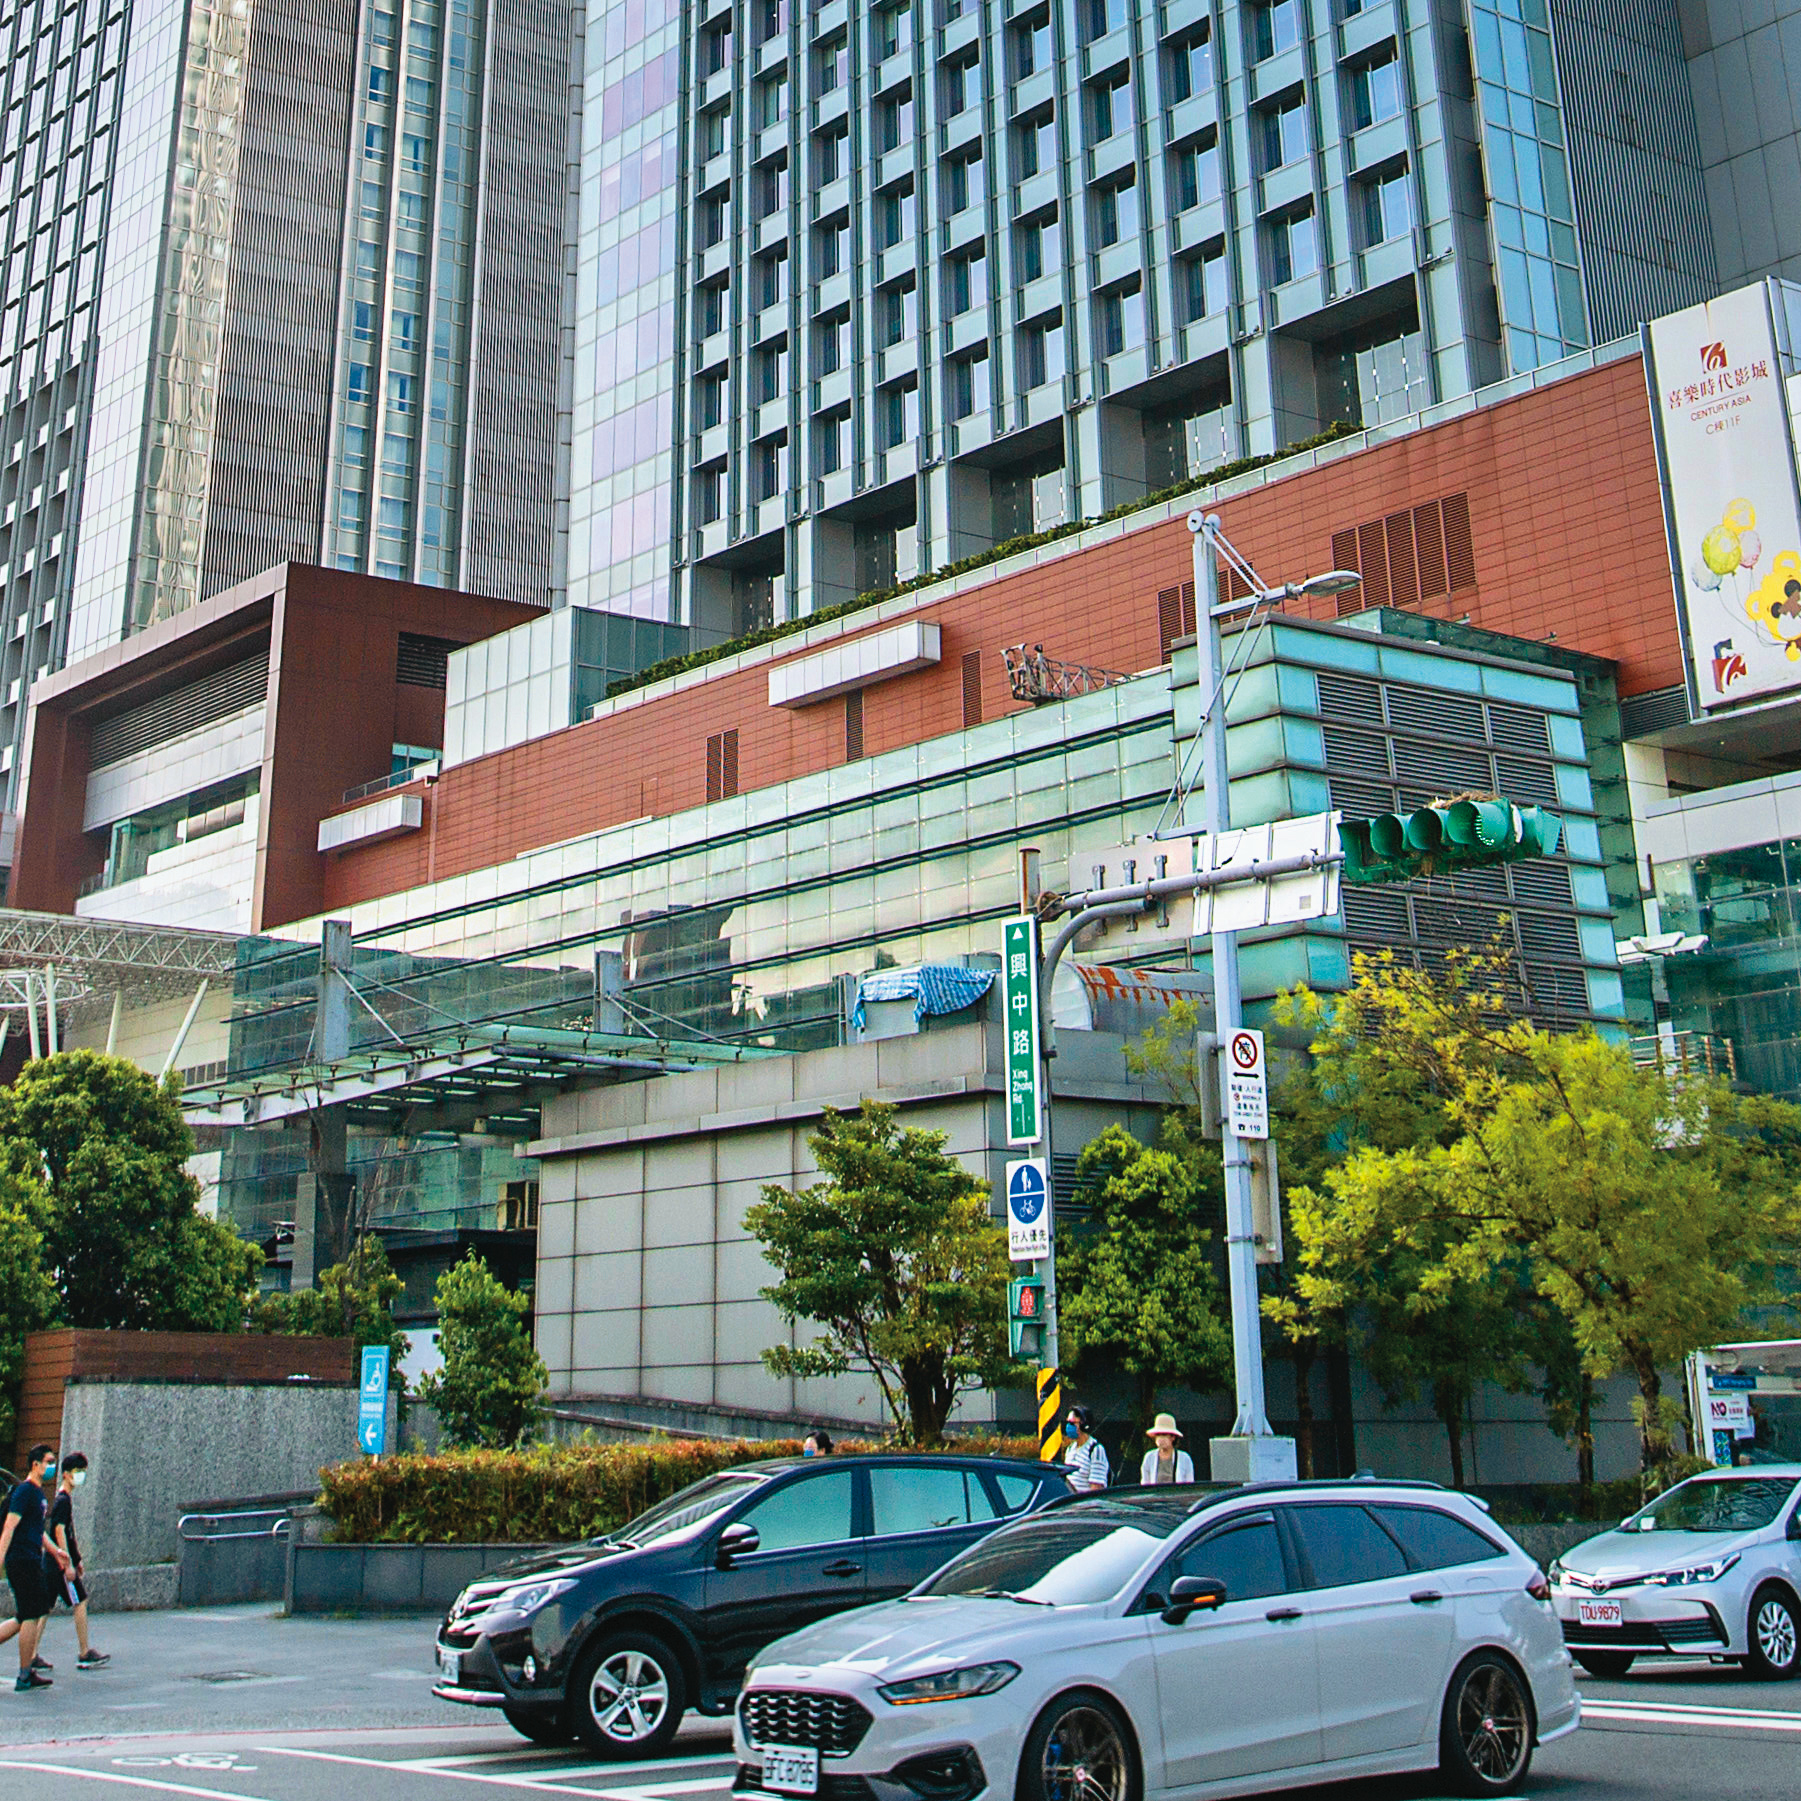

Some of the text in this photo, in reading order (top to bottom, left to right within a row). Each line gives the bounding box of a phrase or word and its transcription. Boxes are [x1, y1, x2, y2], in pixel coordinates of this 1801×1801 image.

[1668, 360, 1769, 409] 喜樂時代影城
[1690, 395, 1751, 421] CENTURY ASIA
[1011, 952, 1029, 1056] 興中路
[1013, 1069, 1028, 1081] Xing
[1013, 1081, 1033, 1093] Zhong
[1711, 1401, 1727, 1416] NO
